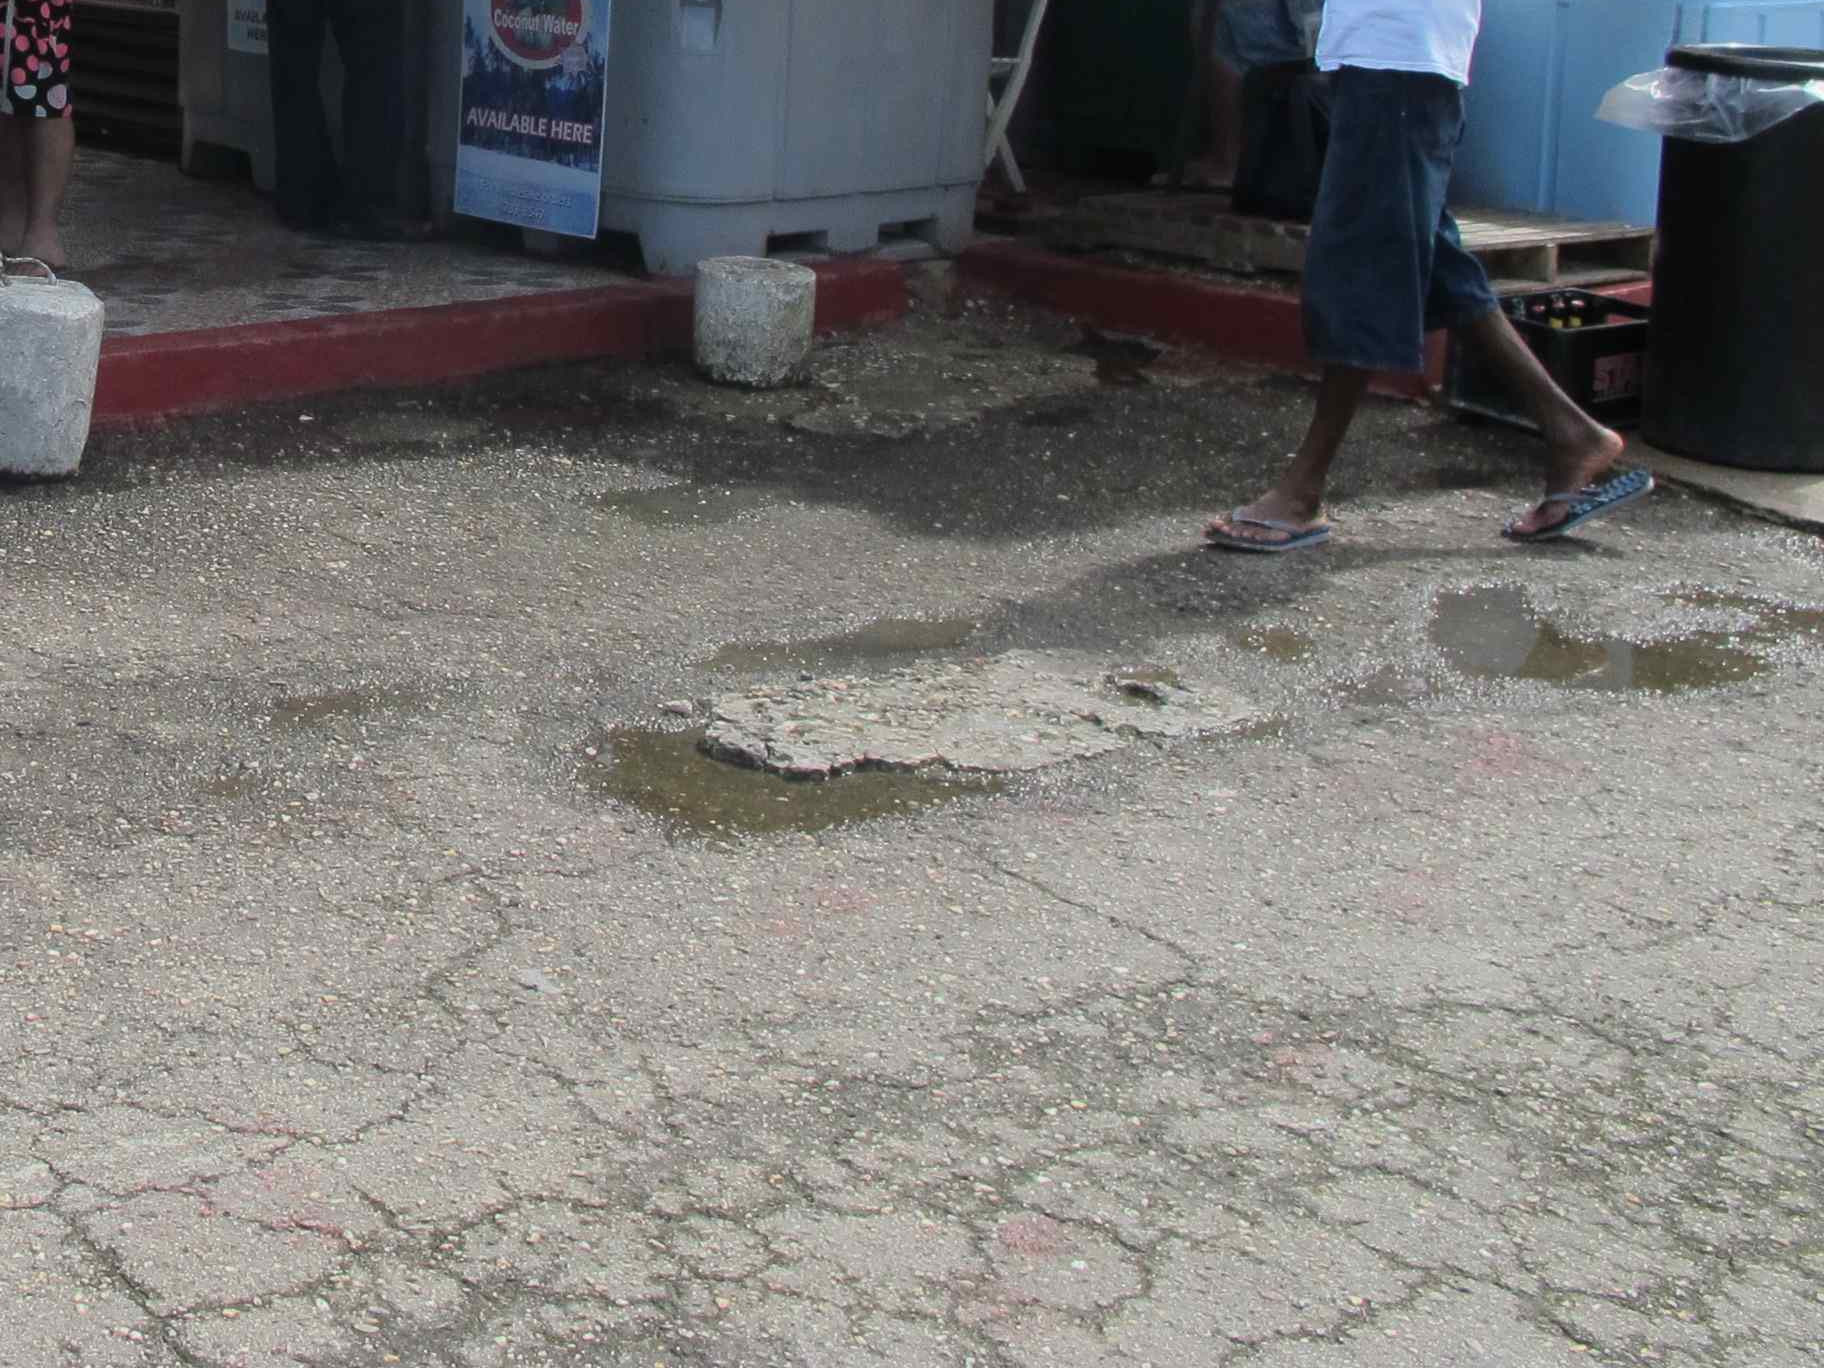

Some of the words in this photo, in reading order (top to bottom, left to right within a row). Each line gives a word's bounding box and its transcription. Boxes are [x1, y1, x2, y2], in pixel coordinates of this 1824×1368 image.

[494, 7, 540, 33] Coconut
[541, 13, 579, 38] Water
[466, 105, 548, 138] AVAILABLE
[549, 120, 593, 144] HERE
